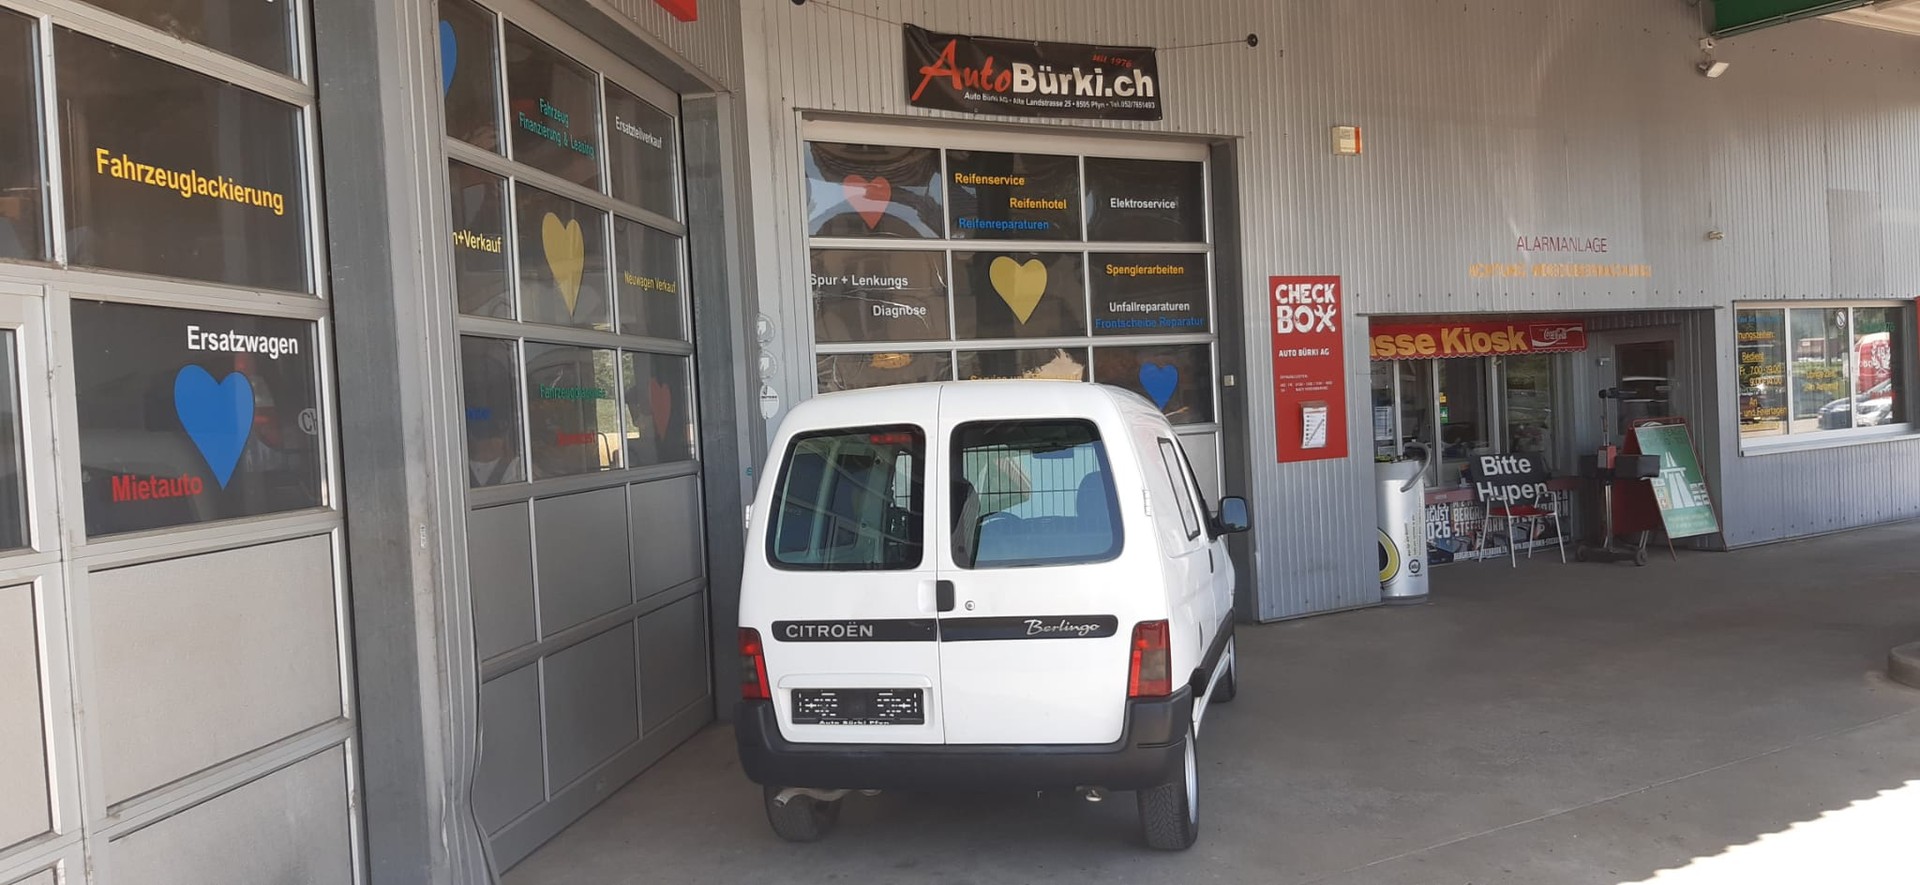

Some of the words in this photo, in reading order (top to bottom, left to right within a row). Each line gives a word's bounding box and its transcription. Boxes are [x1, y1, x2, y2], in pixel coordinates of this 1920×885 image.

[964, 91, 981, 100] Auto
[1026, 98, 1063, 107] Landstrasse
[540, 98, 569, 128] Fahrzeug
[96, 147, 284, 216] Fahrzeuglackierung
[955, 172, 1025, 186] Reifenservice
[1009, 197, 1067, 210] Reifenhotel
[1110, 197, 1176, 209] Elektroservice
[959, 217, 1049, 230] Reifenreparaturen
[1516, 236, 1608, 253] ALARMANLAGE
[1106, 264, 1184, 277] Spenglerarbeiten
[810, 273, 838, 288] Spur
[852, 274, 908, 288] Lenkungs
[1275, 284, 1335, 304] CHECK
[873, 305, 926, 318] Diagnose
[1109, 302, 1190, 313] Unfallreparaturen
[1276, 304, 1336, 333] BOX
[187, 326, 299, 359] Ersatzwagen
[1441, 326, 1528, 353] Kiosk
[1279, 349, 1297, 358] AUTO
[1298, 347, 1319, 357] BÜRKI
[1321, 348, 1330, 356] AG
[1480, 456, 1531, 476] Bitte
[112, 474, 203, 502] Mietauto
[1476, 481, 1548, 504] Hupen
[785, 621, 874, 639] CITROËN
[1023, 618, 1100, 637] Berlingo
